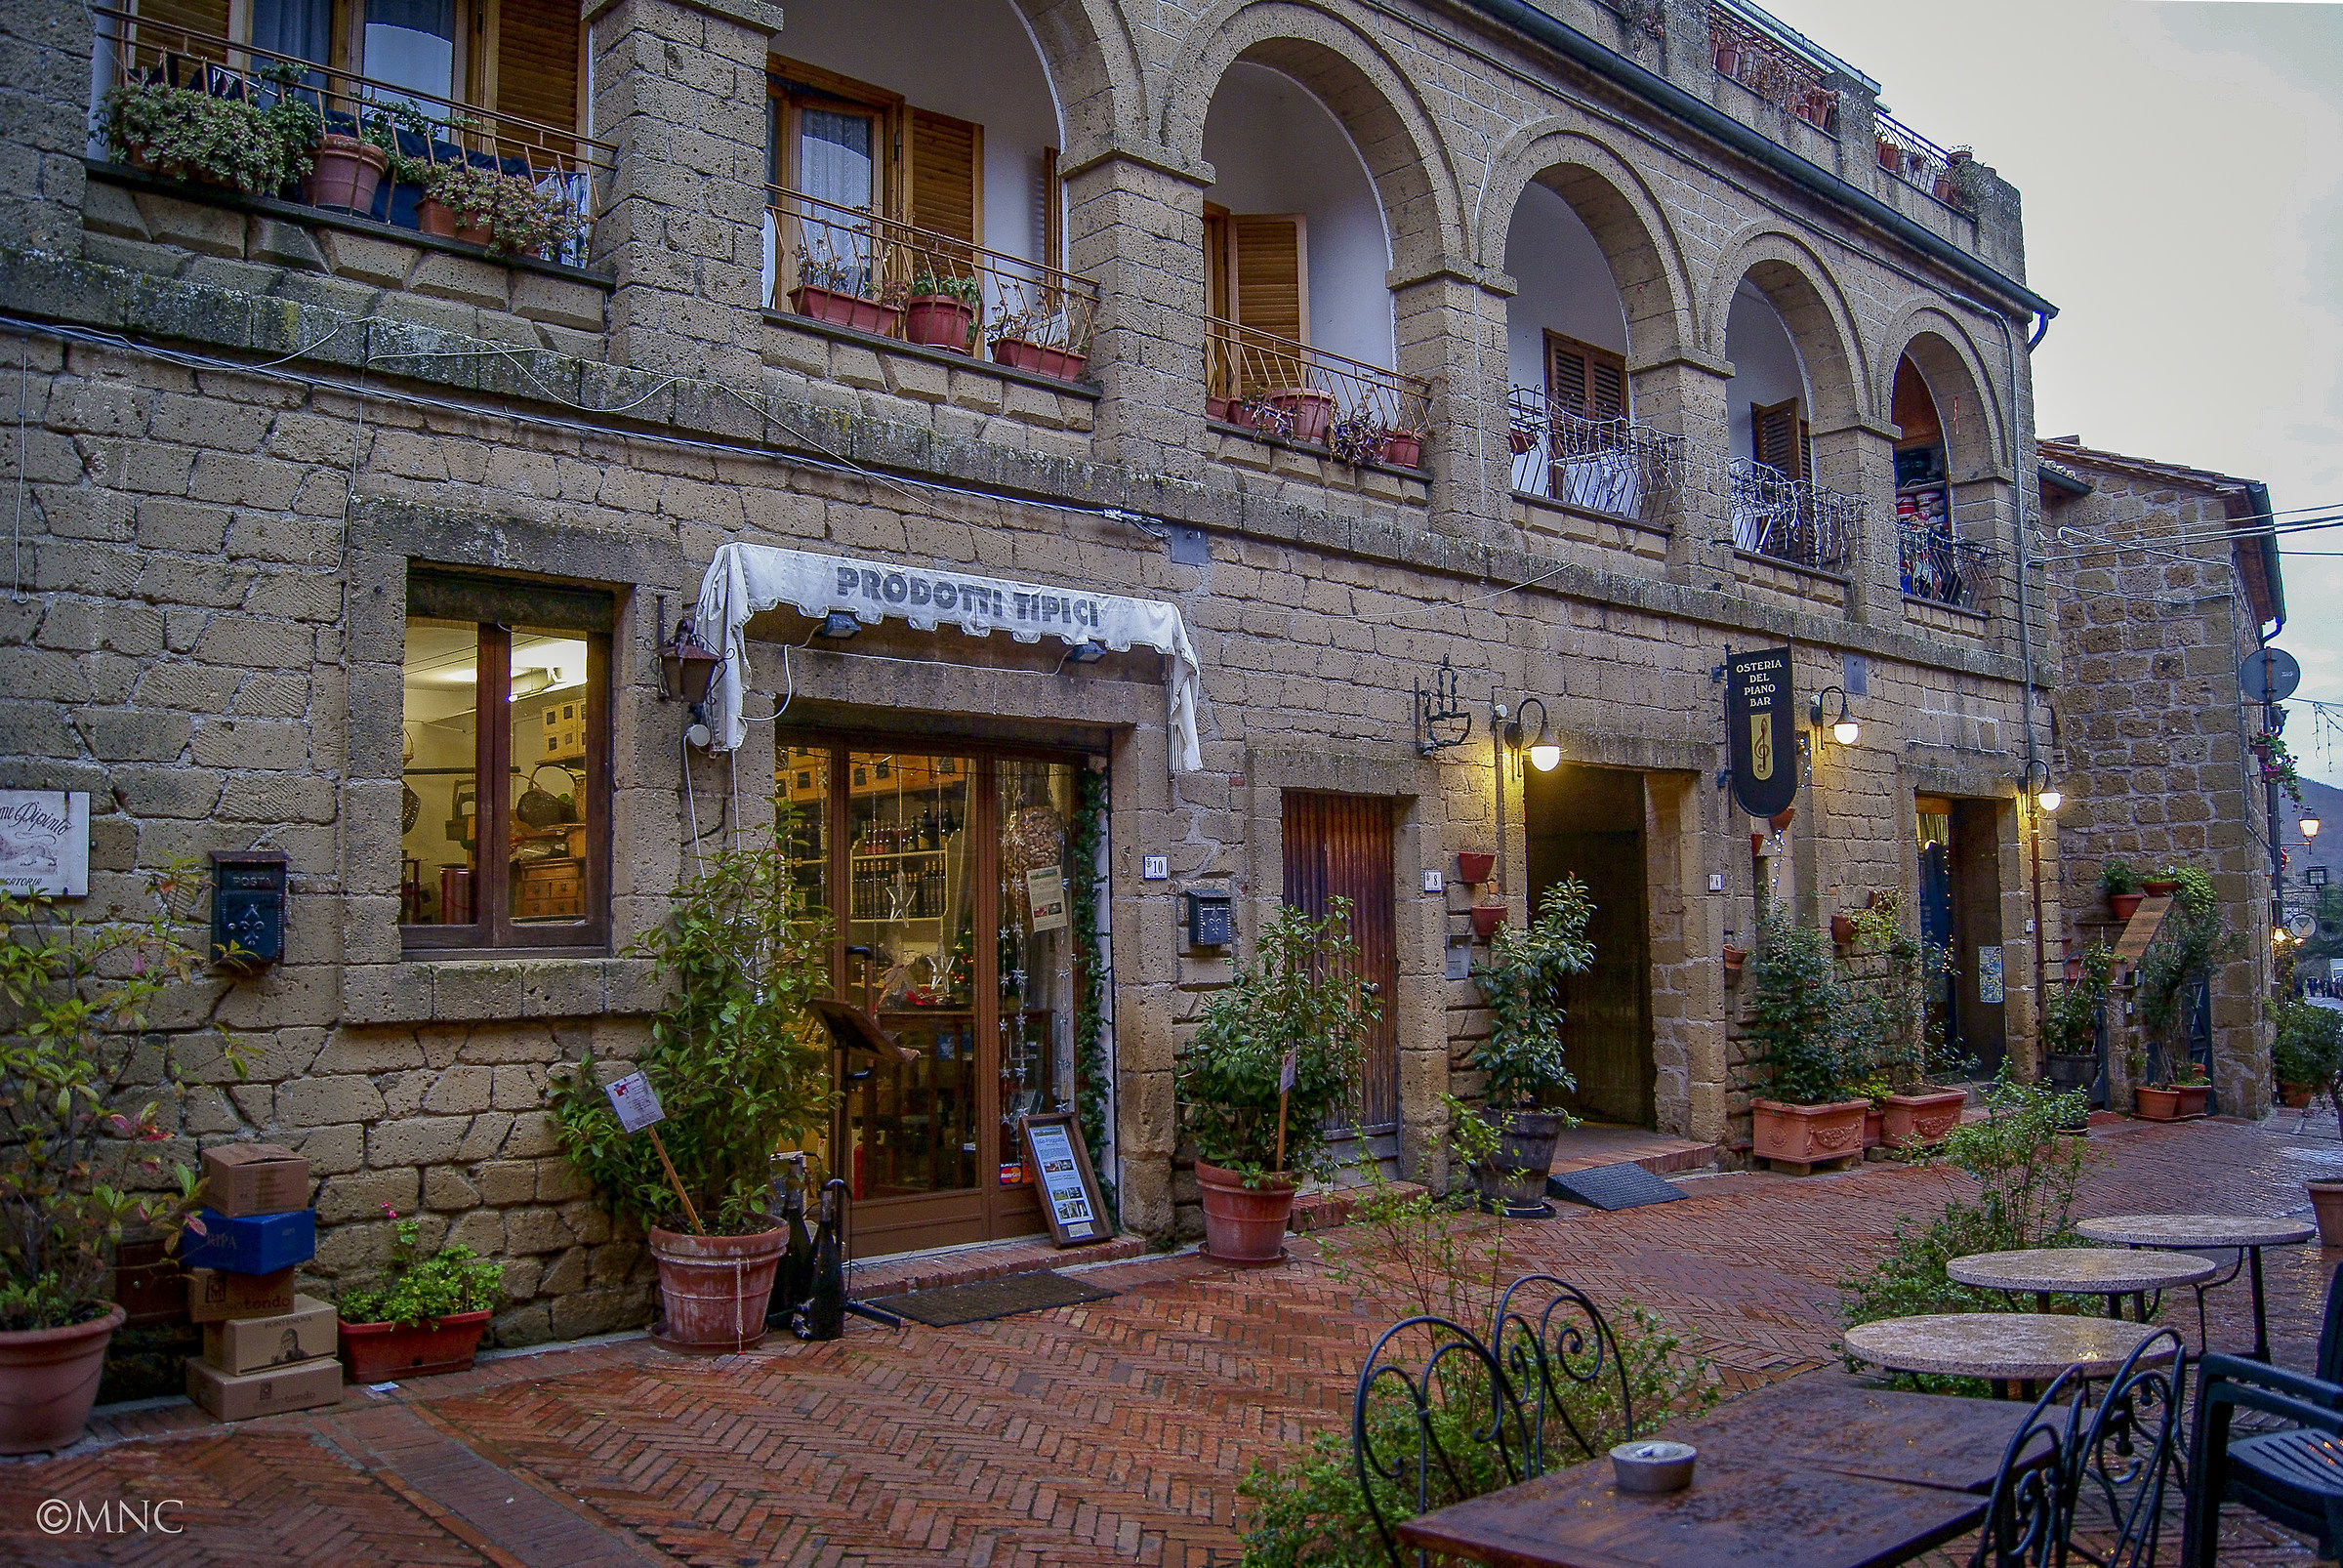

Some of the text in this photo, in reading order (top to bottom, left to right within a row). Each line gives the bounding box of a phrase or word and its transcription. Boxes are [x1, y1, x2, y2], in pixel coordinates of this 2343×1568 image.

[837, 566, 1098, 627] PRODOTTI TIPICI
[1736, 659, 1783, 674] OSTERIA
[1748, 673, 1770, 683] DEL
[1744, 683, 1776, 696] PIANO
[1749, 696, 1772, 708] BAR
[1153, 860, 1165, 873] 10
[1433, 875, 1438, 887] 8
